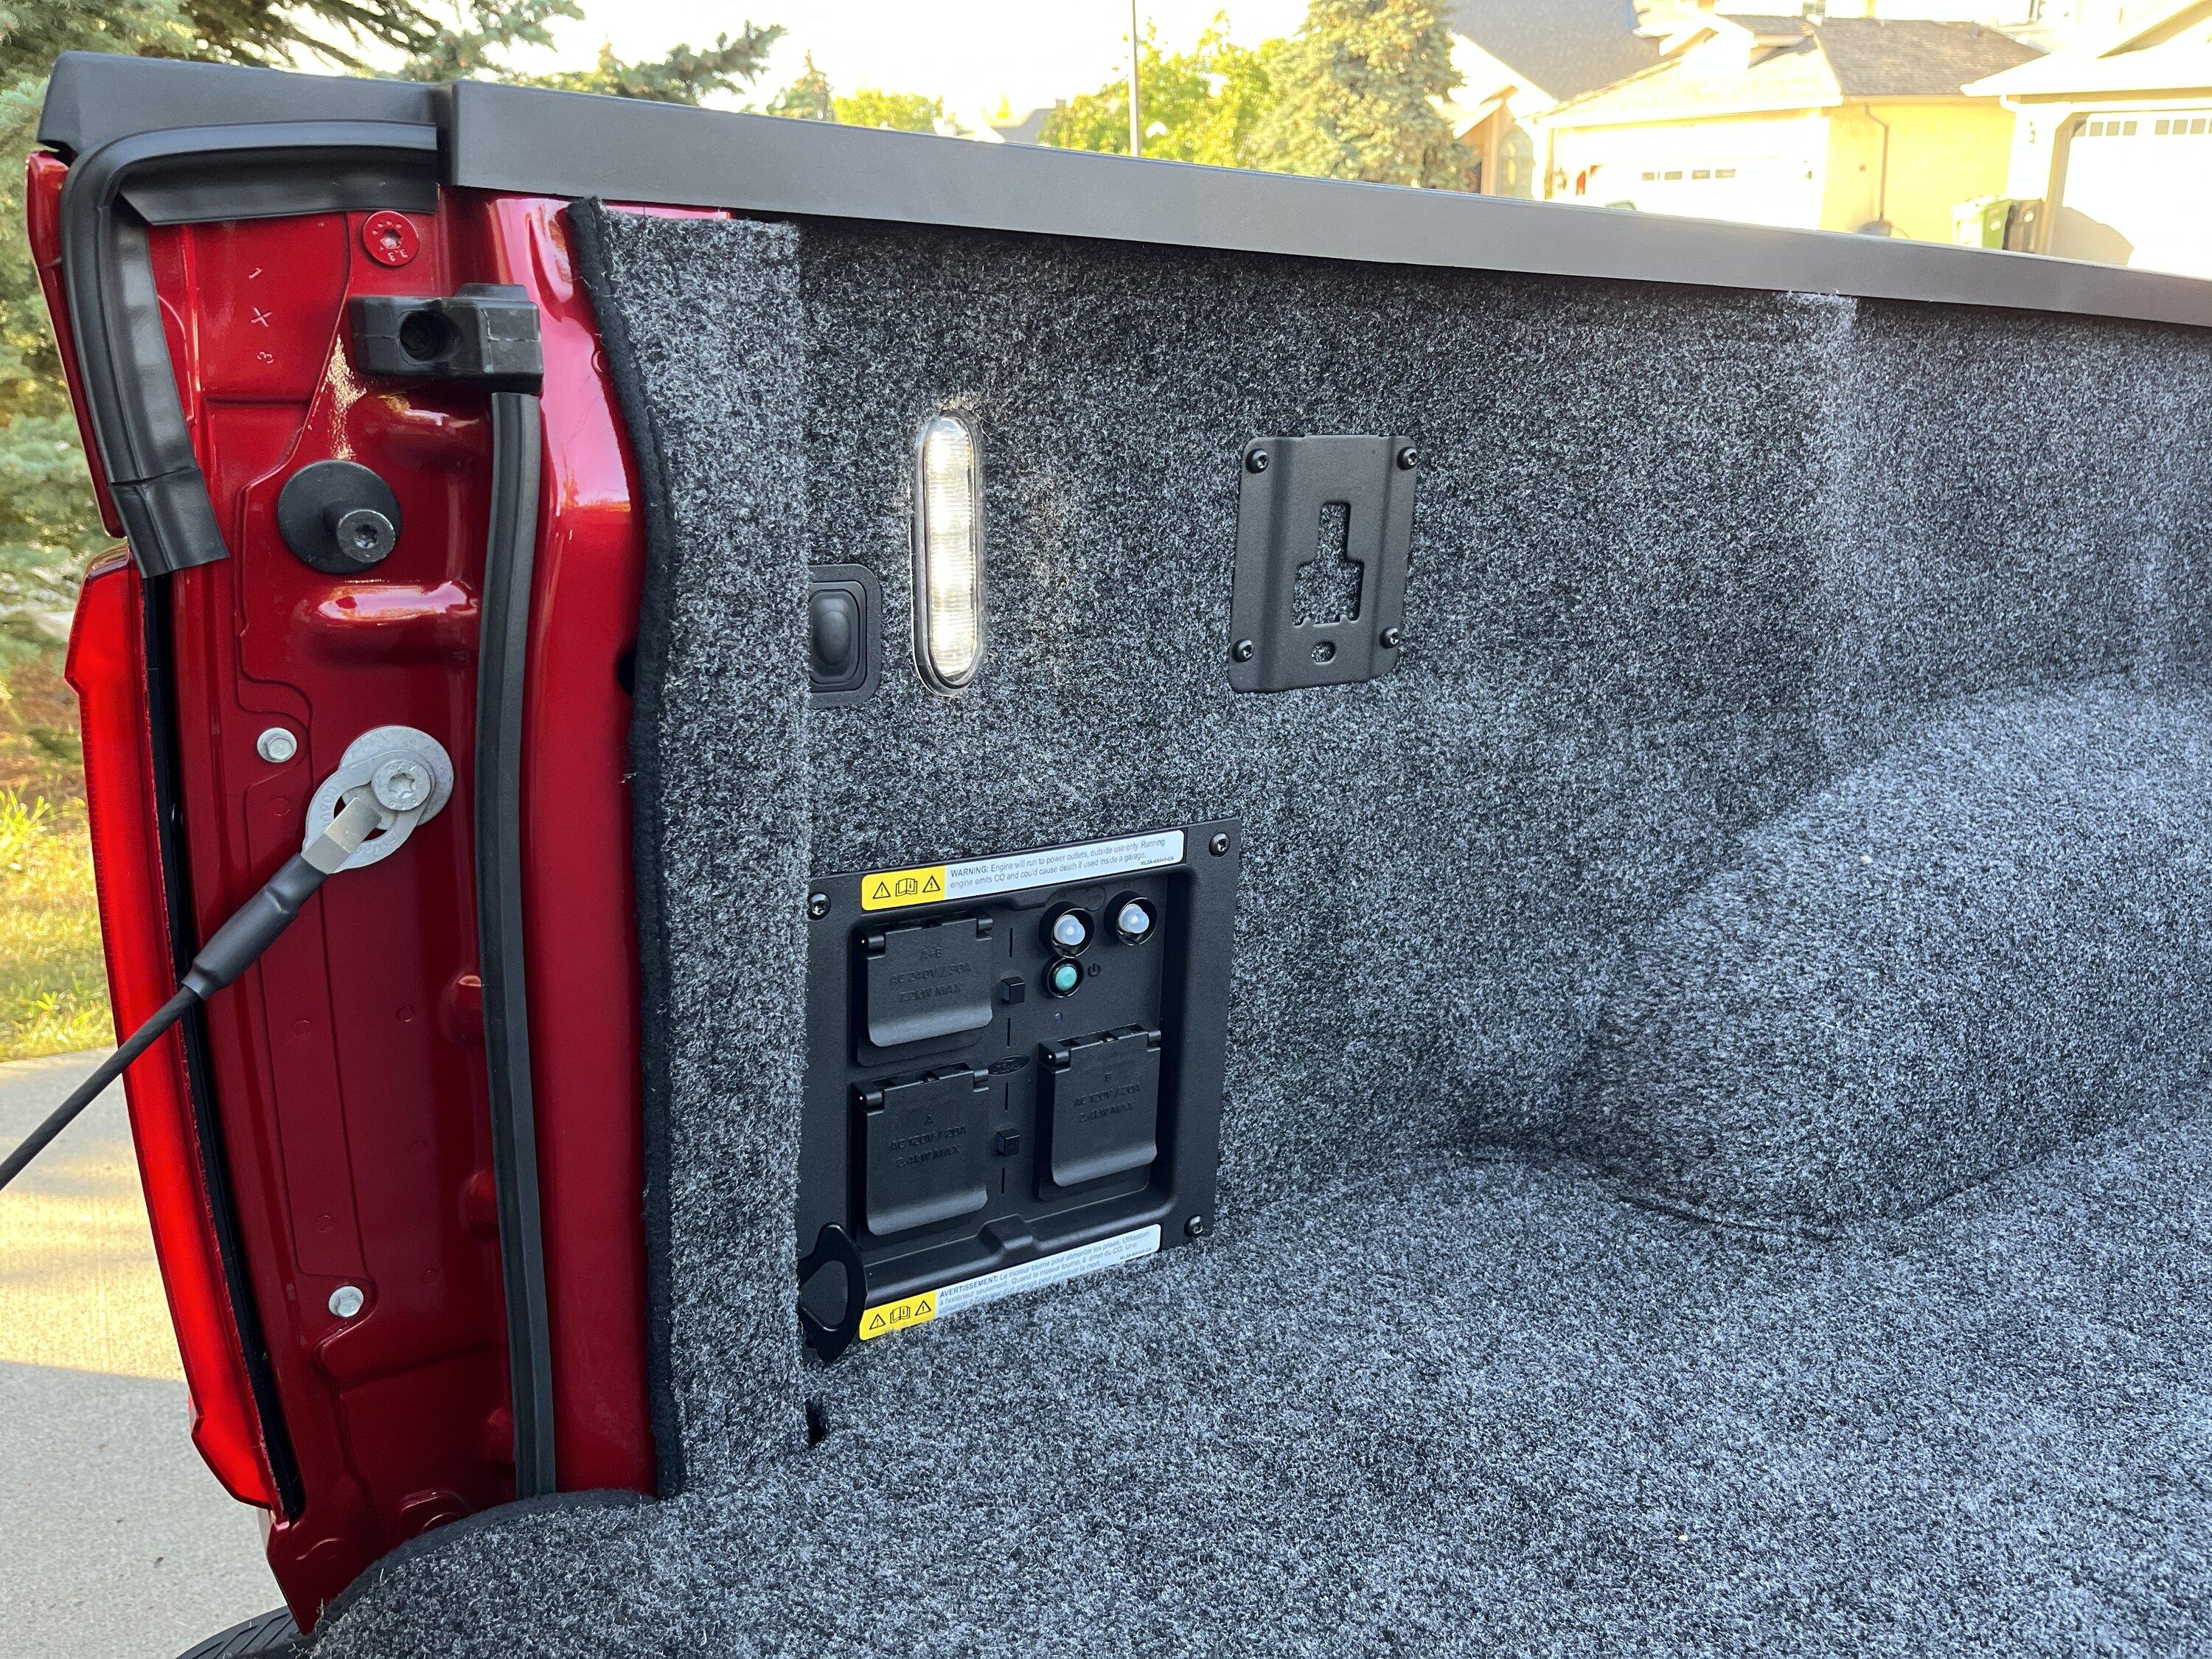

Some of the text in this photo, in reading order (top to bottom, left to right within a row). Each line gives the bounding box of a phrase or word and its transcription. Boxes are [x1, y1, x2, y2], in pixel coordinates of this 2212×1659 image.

[950, 866, 989, 877] WARNING:
[991, 863, 1013, 874] Engine
[1015, 860, 1025, 869] will
[1046, 855, 1065, 866] power
[1067, 850, 1089, 860] outlets,
[1091, 845, 1112, 857] outside
[1113, 845, 1124, 853] use
[1126, 842, 1140, 852] only.
[1141, 838, 1165, 848] Running
[950, 879, 973, 890] engine
[975, 875, 992, 885] emits
[994, 873, 1005, 882] CO
[1006, 871, 1019, 880] and
[1020, 868, 1037, 878] could
[1039, 866, 1058, 875] cause
[1060, 860, 1077, 872] death
[1078, 858, 1083, 869] if
[1084, 856, 1099, 868] used
[1100, 853, 1118, 865] inside
[1124, 852, 1147, 863] garage.
[939, 1275, 998, 1298] AVERTISSEMENT:
[1000, 1272, 1008, 1280] Le
[1009, 1267, 1030, 1277] moteur
[1031, 1260, 1050, 1271] tourne
[1051, 1256, 1065, 1267] pour
[1066, 1248, 1092, 1261] alimenter
[1093, 1244, 1102, 1252] les
[1122, 1231, 1150, 1243] Utilisation
[1012, 1274, 1032, 1284] Quand
[1040, 1265, 1060, 1276] moteur
[1125, 1242, 1137, 1251] Une
[939, 1300, 967, 1314] utilisation
[1016, 1280, 1037, 1293] garage
[1038, 1276, 1052, 1287] peut
[1080, 1264, 1085, 1272] la
